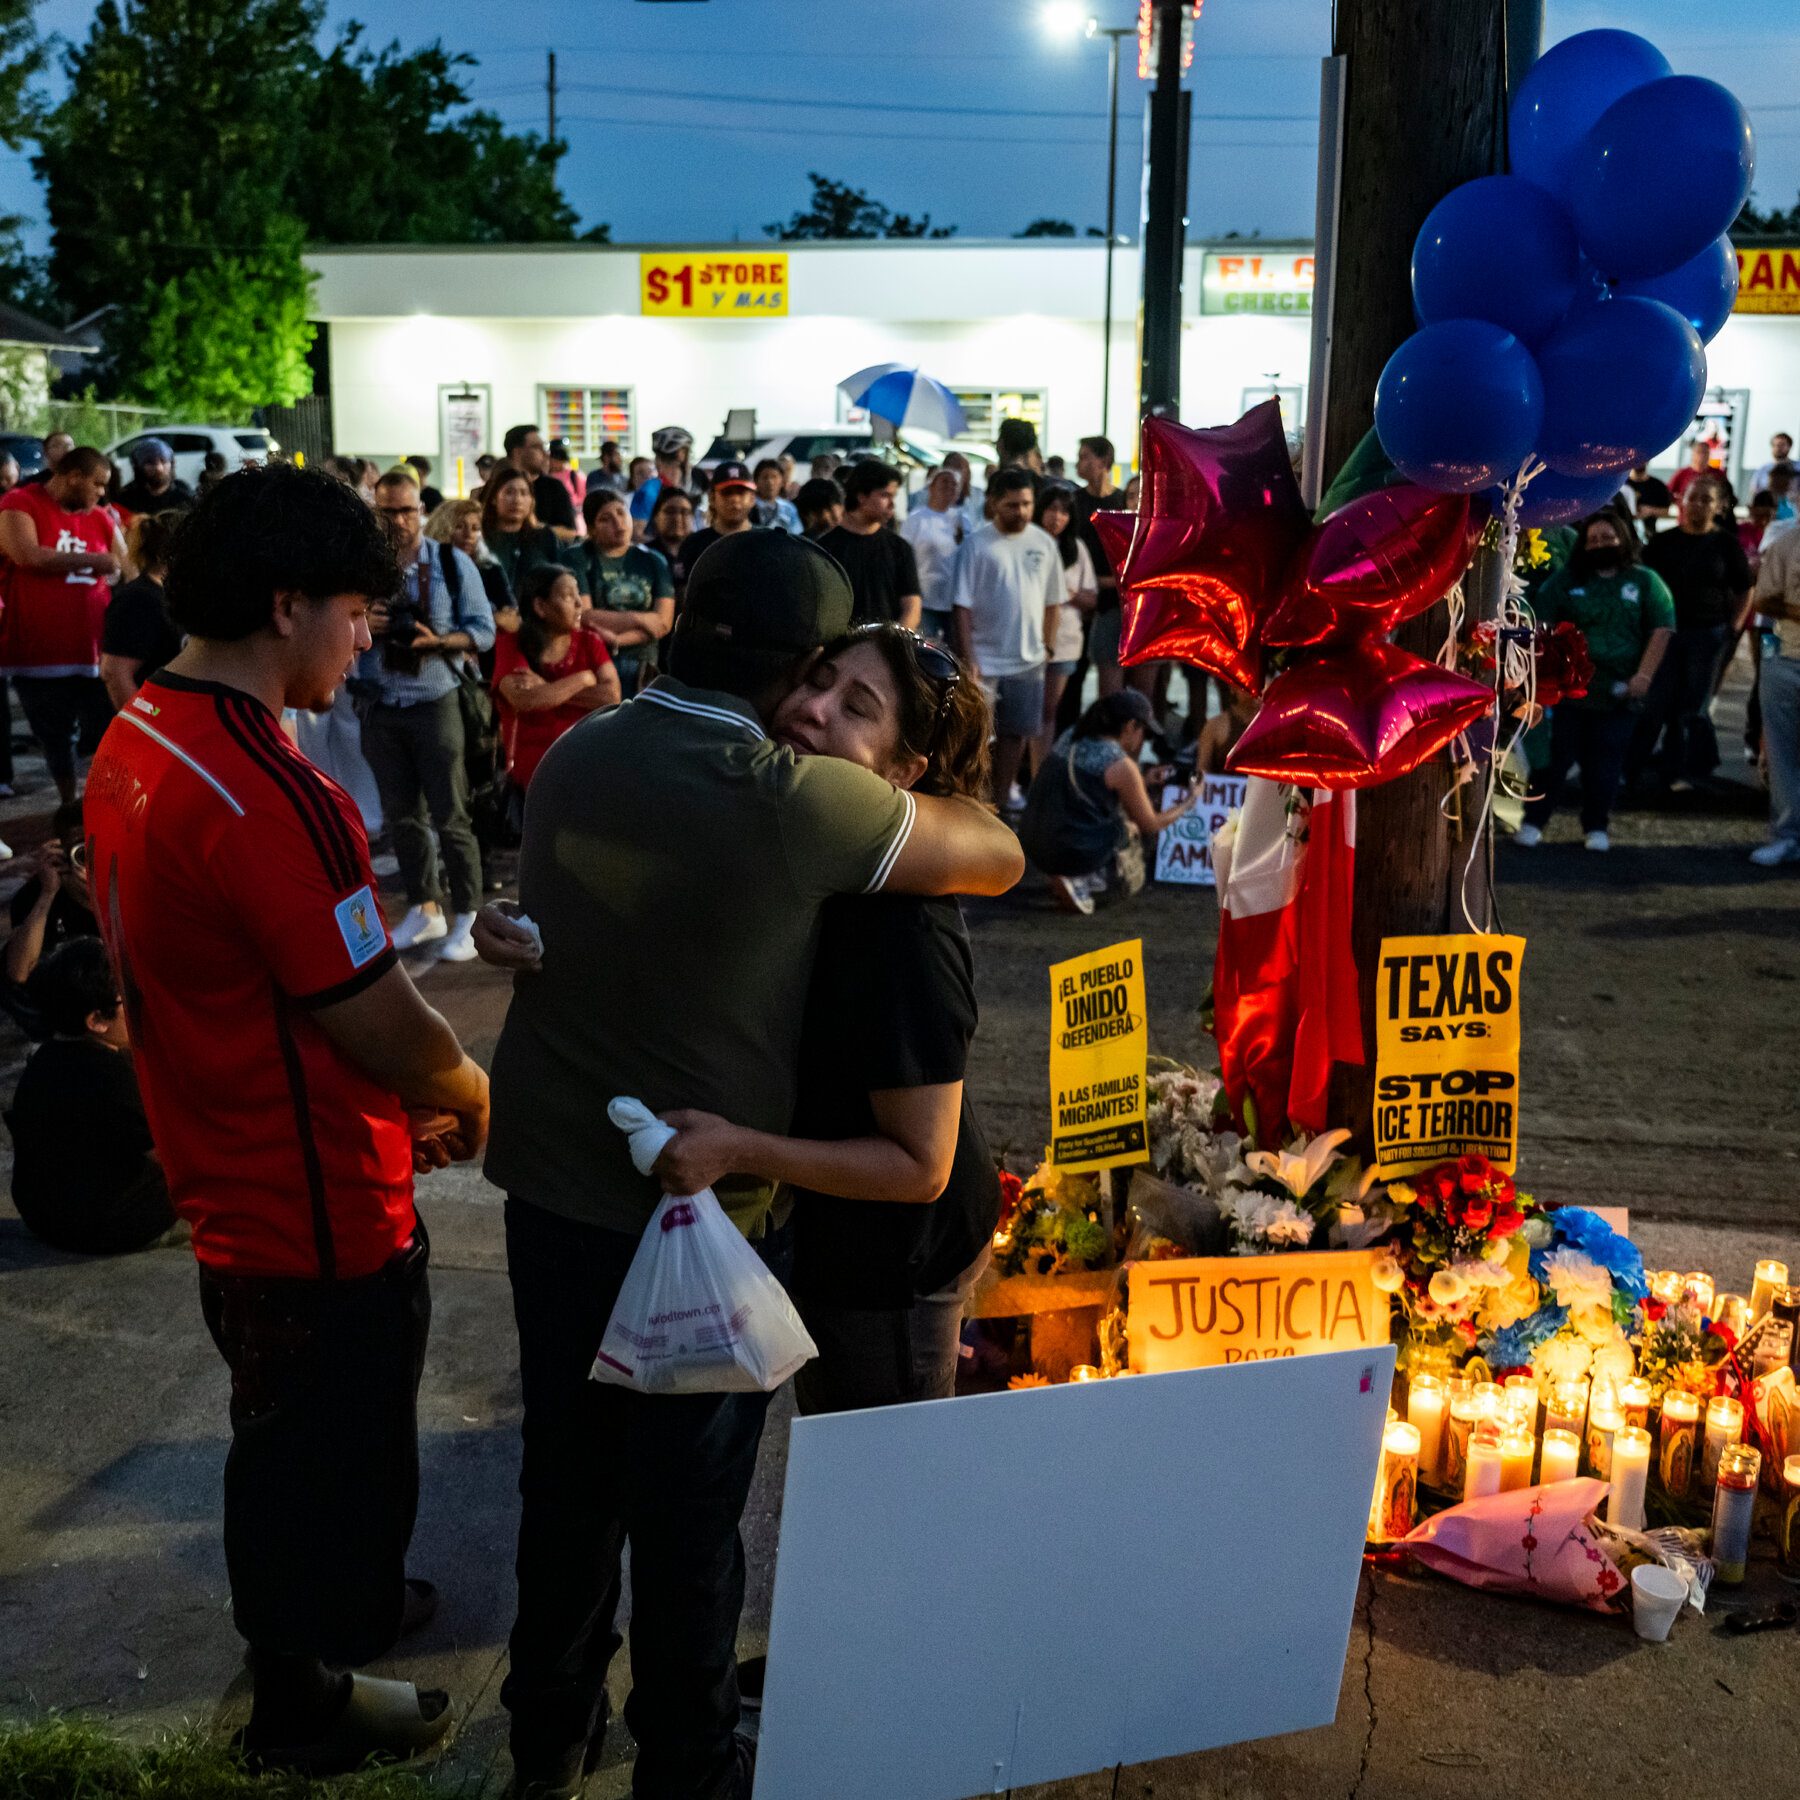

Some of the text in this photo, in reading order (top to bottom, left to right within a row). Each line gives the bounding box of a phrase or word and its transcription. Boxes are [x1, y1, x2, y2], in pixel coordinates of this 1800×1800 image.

[647, 263, 784, 308] $1 STORE
[711, 291, 783, 309] Y MAS
[1080, 958, 1134, 992] PUEBLO
[1383, 950, 1513, 1020] TEXAS
[1066, 984, 1128, 1029] UNIDO
[1400, 1021, 1492, 1043] SAYS:
[1058, 1074, 1139, 1107] A LAS FAMILIAS
[1378, 1070, 1515, 1102] STOP
[1059, 1093, 1139, 1128] MIGRANTES!
[1378, 1099, 1513, 1143] ICE TERROR
[1149, 1276, 1366, 1342] JUSTICIA
